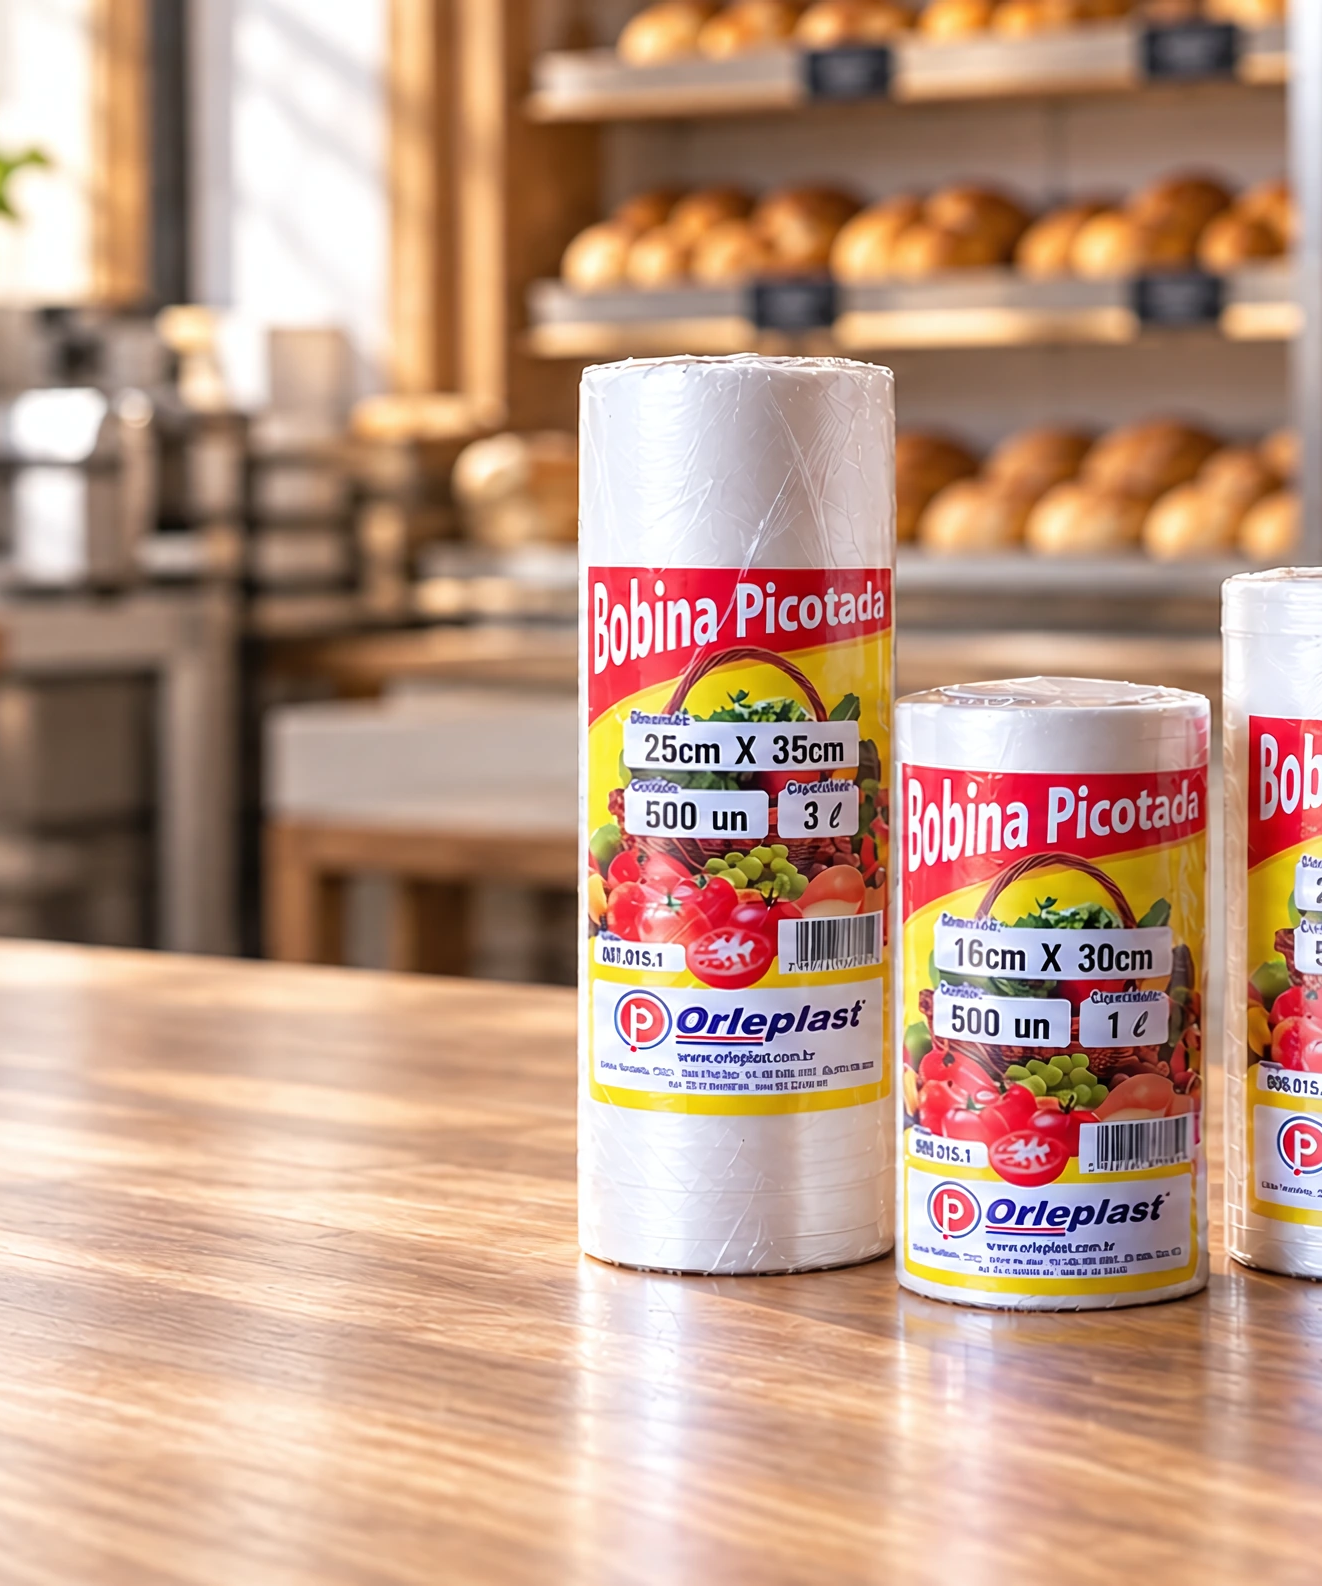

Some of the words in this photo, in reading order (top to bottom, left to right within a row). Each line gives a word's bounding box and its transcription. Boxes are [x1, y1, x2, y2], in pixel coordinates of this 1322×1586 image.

[594, 577, 718, 675] Bobina
[736, 581, 884, 638] Picotada
[644, 733, 721, 764] 25cm
[734, 735, 756, 765] X
[772, 735, 844, 764] 35cm
[645, 800, 697, 830] 500
[712, 809, 748, 831] un
[803, 801, 819, 830] 3
[907, 778, 1028, 872] Bobina
[1046, 779, 1199, 844] Picotada
[954, 937, 1026, 972] 16cm
[1040, 943, 1062, 972] X
[1078, 943, 1153, 972] 30cm
[677, 1001, 860, 1042] Orleplast
[951, 1004, 1000, 1037] 500
[1014, 1017, 1050, 1040] un
[1107, 1011, 1119, 1039] 1
[985, 1193, 1164, 1233] Orleplast
